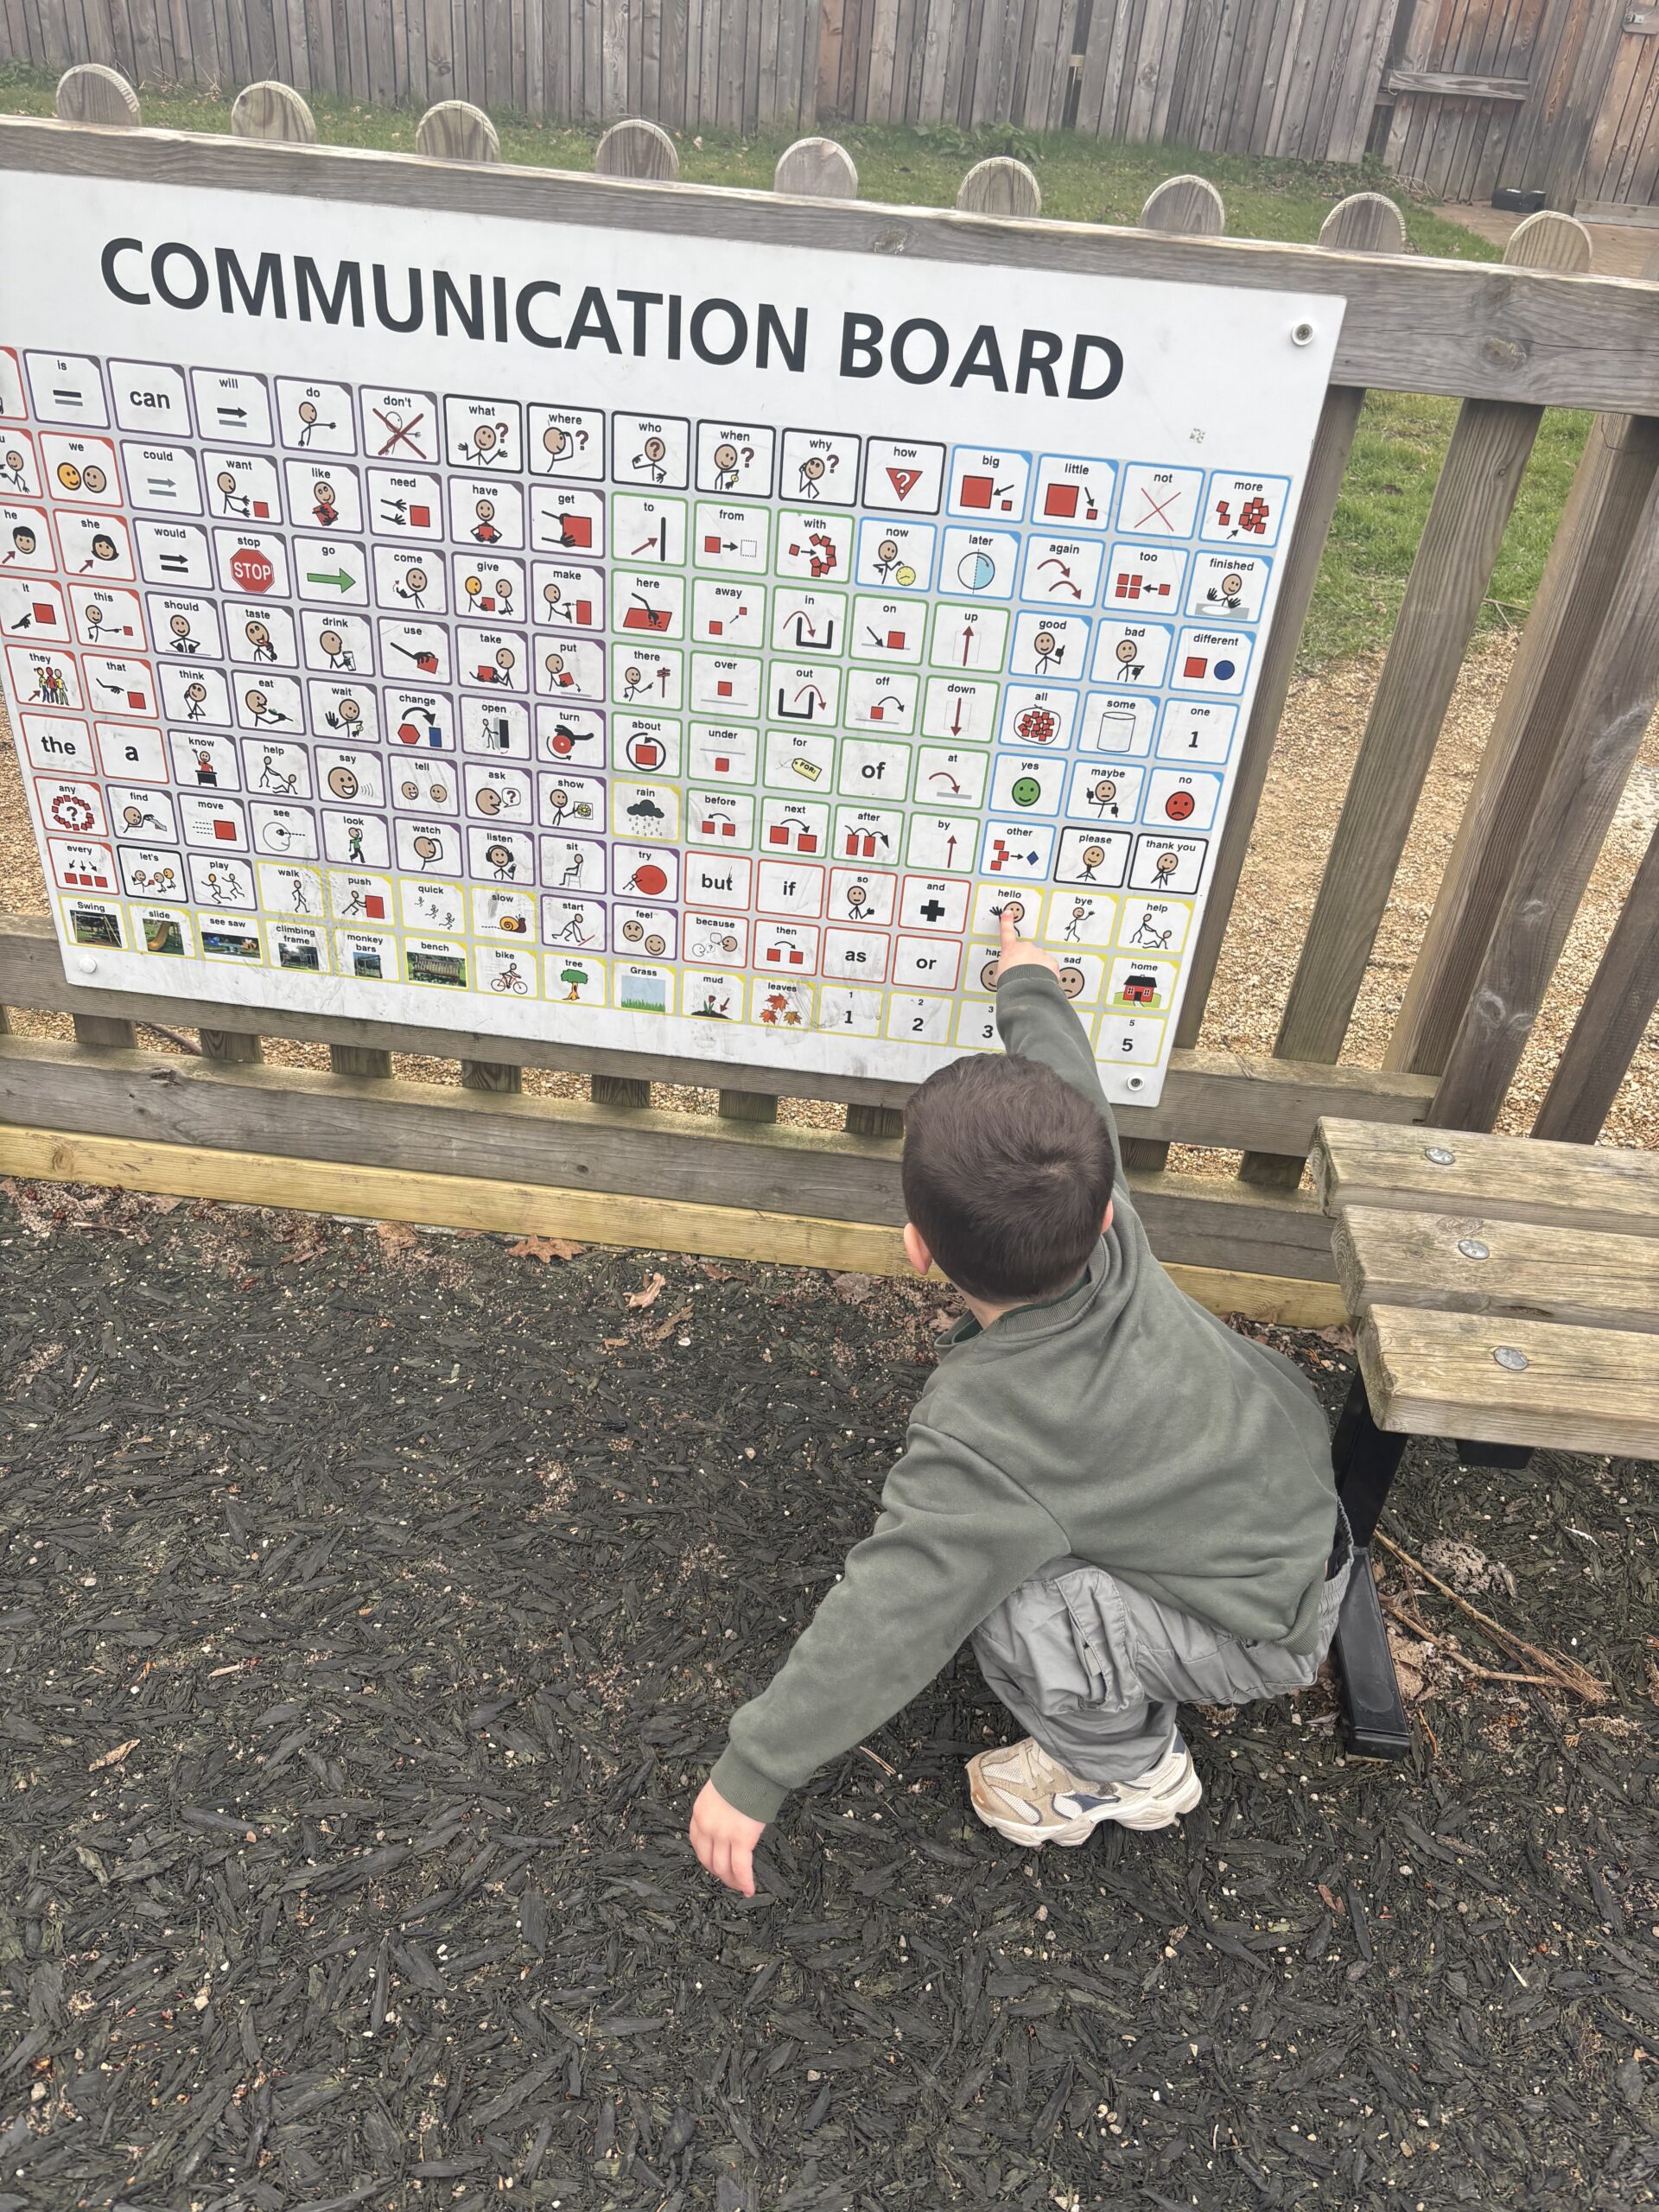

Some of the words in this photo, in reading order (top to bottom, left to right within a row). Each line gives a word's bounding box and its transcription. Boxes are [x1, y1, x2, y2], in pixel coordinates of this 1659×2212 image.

[100, 237, 809, 373] COMMUNICATION
[839, 311, 1124, 401] BOARD
[56, 359, 67, 371] is
[219, 378, 238, 390] will
[305, 386, 321, 398] do
[130, 391, 170, 410] can
[383, 395, 412, 408] don't
[468, 404, 495, 416] what
[547, 412, 582, 426] where
[639, 422, 662, 433] who
[720, 429, 750, 442] when
[68, 442, 85, 452] we
[809, 438, 832, 452] why
[143, 450, 174, 461] could
[893, 446, 918, 458] how
[226, 460, 253, 471] want
[982, 454, 1000, 469] big
[311, 467, 331, 480] like
[1065, 462, 1090, 475] little
[390, 478, 416, 488] need
[1154, 474, 1173, 483] not
[472, 484, 499, 497] have
[1233, 481, 1263, 492] more
[557, 494, 575, 505] get
[644, 502, 655, 512] to
[3, 509, 18, 520] he
[719, 509, 745, 521] from
[80, 518, 100, 530] she
[804, 518, 827, 530] with
[154, 528, 187, 539] would
[886, 528, 910, 537] now
[237, 537, 261, 549] stop
[969, 534, 994, 546] later
[321, 546, 336, 556] go
[1049, 543, 1080, 556] again
[393, 554, 423, 564] come
[1140, 551, 1158, 563] too
[476, 561, 499, 573] give
[1209, 557, 1255, 571] finished
[232, 562, 274, 581] STOP
[553, 569, 582, 581] make
[636, 577, 660, 589] here
[93, 592, 114, 602] this
[715, 587, 742, 600] away
[804, 594, 815, 606] in
[163, 600, 200, 612] should
[882, 605, 897, 613] on
[245, 608, 270, 620] taste
[964, 613, 979, 623] up
[322, 616, 348, 628] drink
[1039, 620, 1067, 630] good
[404, 626, 423, 636] use
[1124, 626, 1146, 638] bad
[480, 633, 502, 645] take
[1193, 633, 1239, 646] different
[559, 644, 577, 653] put
[29, 652, 51, 665] they
[633, 651, 661, 662] there
[106, 661, 127, 672] that
[714, 661, 738, 670] over
[179, 670, 205, 681] think
[796, 669, 813, 678] out
[258, 679, 274, 689] eat
[875, 677, 891, 686] off
[331, 687, 353, 696] wait
[947, 683, 976, 695] down
[398, 694, 436, 707] change
[1034, 692, 1048, 702] all
[481, 704, 507, 714] open
[1106, 700, 1136, 709] some
[559, 711, 580, 722] turn
[1190, 708, 1211, 716] one
[632, 720, 661, 732] about
[708, 729, 738, 740] under
[1188, 730, 1198, 748] 1
[41, 735, 76, 755] the
[188, 736, 215, 747] know
[792, 737, 808, 747] for
[124, 746, 139, 762] a
[263, 744, 284, 757] help
[339, 754, 357, 765] say
[947, 754, 958, 763] at
[414, 761, 429, 772] tell
[861, 761, 887, 780] of
[1020, 761, 1039, 772] yes
[488, 772, 506, 780] ask
[1090, 768, 1126, 779] maybe
[557, 779, 585, 789] show
[58, 785, 76, 795] any
[636, 788, 656, 798] rain
[130, 791, 149, 802] find
[704, 794, 736, 806] before
[197, 801, 224, 810] move
[784, 805, 806, 814] next
[343, 816, 365, 826] look
[857, 811, 880, 822] after
[412, 825, 442, 835] watch
[938, 819, 950, 831] by
[486, 832, 513, 843] listen
[1006, 827, 1033, 837] other
[1078, 834, 1112, 844] please
[67, 845, 92, 856] every
[566, 842, 578, 851] sit
[1146, 840, 1174, 850] thank
[1176, 844, 1197, 853] you
[139, 852, 160, 861] let's
[638, 850, 652, 861] try
[209, 861, 229, 872] play
[277, 869, 300, 878] walk
[347, 877, 372, 886] push
[701, 873, 733, 891] but
[417, 885, 444, 894] quick
[783, 880, 797, 896] if
[926, 883, 946, 892] and
[492, 893, 514, 903] slow
[997, 888, 1022, 899] hello
[1074, 896, 1093, 906] bye
[77, 901, 105, 913] Swing
[562, 902, 584, 912] start
[1146, 903, 1168, 914] help
[148, 910, 170, 919] slide
[635, 910, 653, 919] feel
[696, 917, 735, 929] because
[276, 925, 315, 938] climbing
[776, 925, 798, 936] then
[283, 934, 310, 945] frame
[346, 934, 384, 946] monkey
[355, 943, 377, 953] bars
[421, 941, 449, 952] bench
[495, 950, 515, 960] bike
[844, 950, 867, 963] as
[564, 958, 583, 968] tree
[916, 957, 938, 970] or
[1130, 962, 1159, 971] home
[630, 966, 658, 977] Grass
[702, 976, 723, 984] mud
[767, 982, 798, 993] leaves
[918, 998, 924, 1007] 2
[988, 1005, 995, 1014] 3
[844, 1010, 853, 1025] 1
[1128, 1019, 1135, 1027] 5
[912, 1017, 924, 1032] 2
[982, 1024, 994, 1039] 3
[1121, 1038, 1134, 1052] 5
